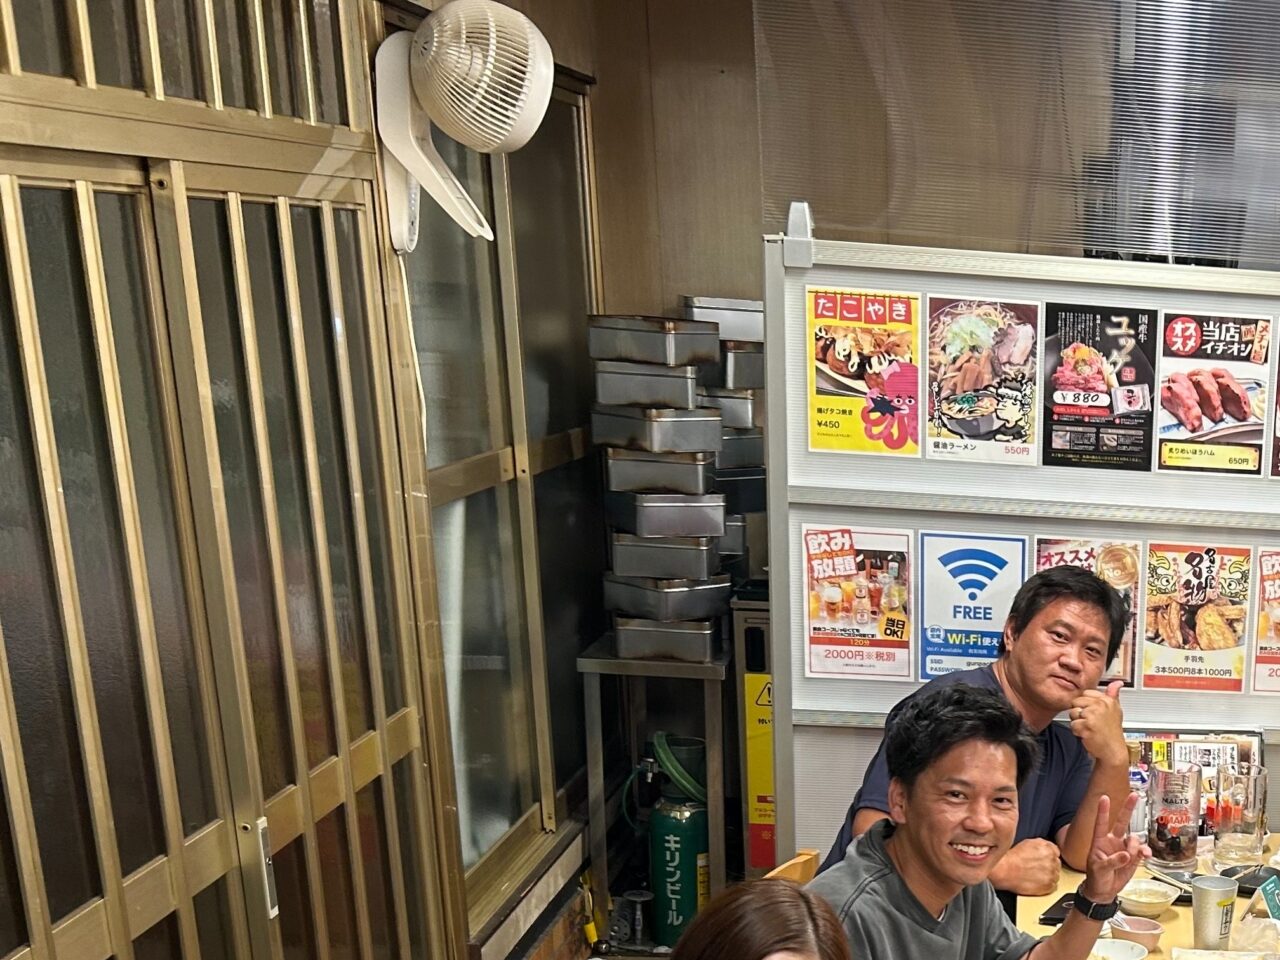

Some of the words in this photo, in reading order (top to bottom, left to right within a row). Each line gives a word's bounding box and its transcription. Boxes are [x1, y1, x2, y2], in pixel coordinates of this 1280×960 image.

[817, 296, 906, 320] たこやき
[1138, 314, 1149, 343] 国産牛
[1203, 322, 1240, 341] 当店
[1105, 315, 1137, 374] ユッケ
[1201, 343, 1252, 356] イチオシ
[817, 420, 840, 429] ¥450
[933, 441, 977, 451] 醤油ラーメン
[1004, 446, 1030, 455] 550円
[1229, 457, 1249, 466] 650円
[1042, 547, 1096, 567] オススメ
[953, 604, 993, 620] FREE
[885, 617, 905, 630] 当日
[1184, 655, 1204, 663] 手羽先
[664, 834, 683, 926] キリンビール
